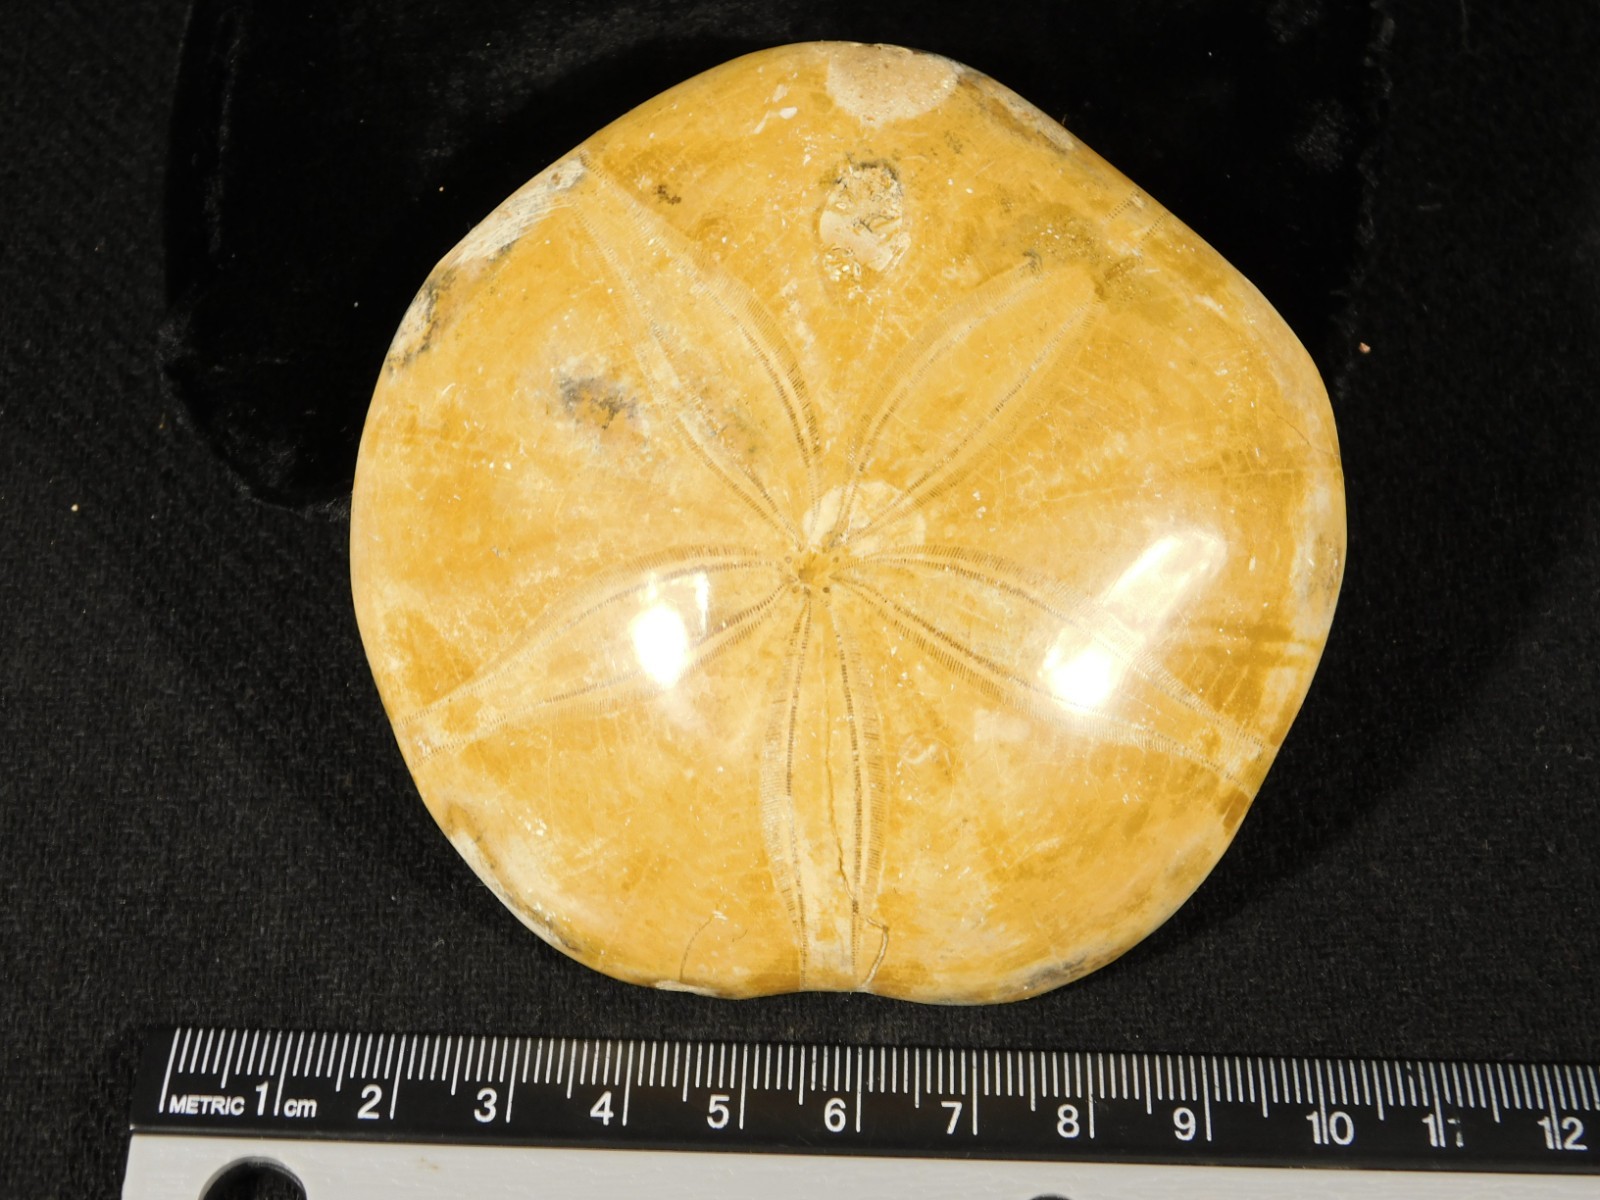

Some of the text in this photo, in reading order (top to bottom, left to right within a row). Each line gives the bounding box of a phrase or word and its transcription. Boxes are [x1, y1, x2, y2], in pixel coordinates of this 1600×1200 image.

[169, 1094, 245, 1115] METRIC
[255, 1081, 269, 1116] 1
[284, 1099, 317, 1118] cm
[357, 1084, 382, 1119] 2
[474, 1087, 498, 1123] 3
[590, 1090, 614, 1126] 4
[706, 1094, 730, 1129] 5
[823, 1097, 846, 1133] 6
[941, 1100, 963, 1135] 7
[1056, 1104, 1080, 1139] 8
[1173, 1107, 1196, 1142] 9
[1306, 1111, 1354, 1145] 10
[1537, 1116, 1588, 1150] 12
